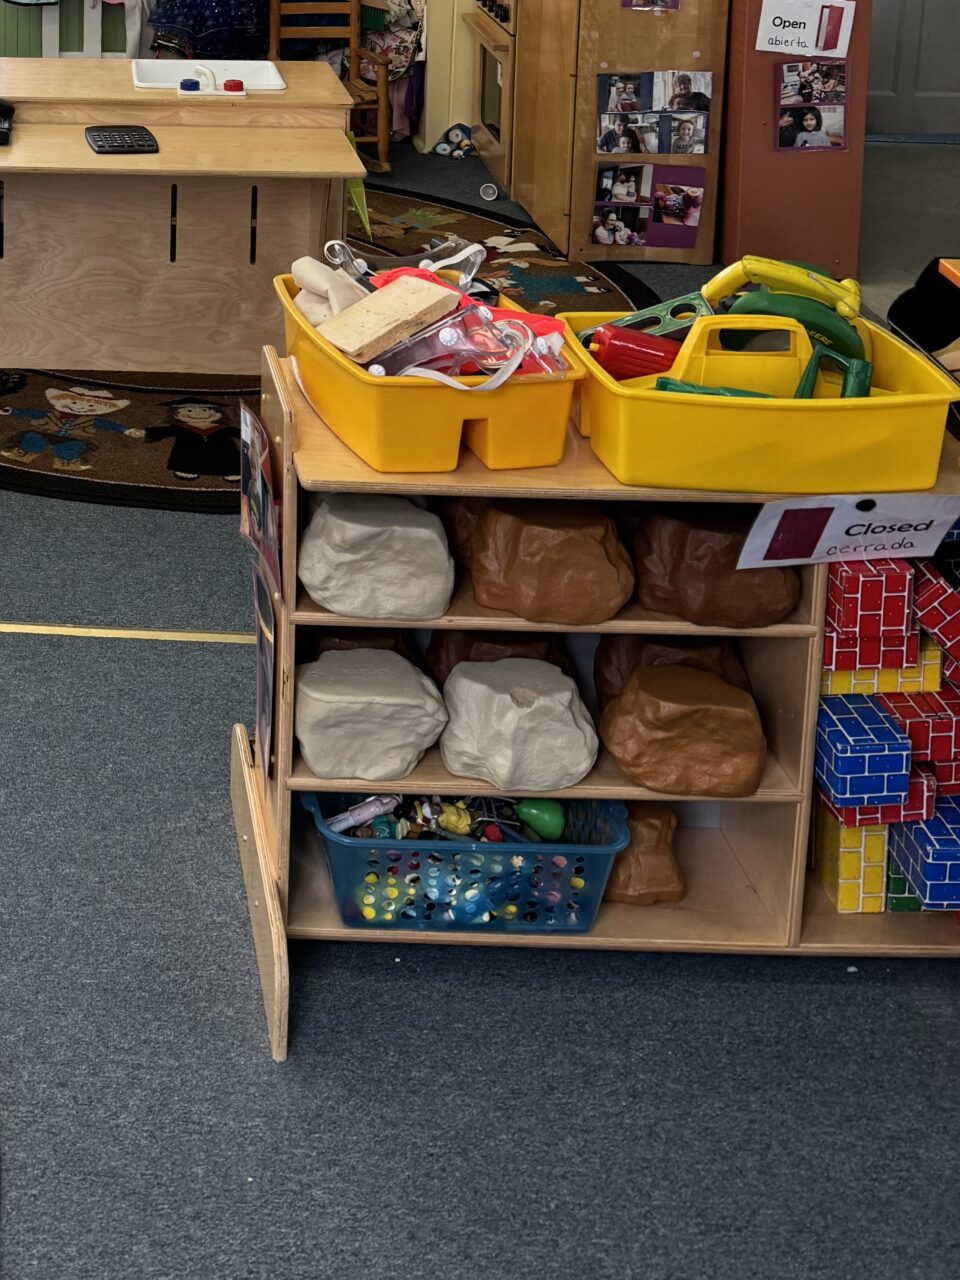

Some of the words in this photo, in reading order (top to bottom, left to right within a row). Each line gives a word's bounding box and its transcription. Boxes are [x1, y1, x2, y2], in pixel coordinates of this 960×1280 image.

[772, 16, 807, 30] Open
[767, 35, 809, 48] abierta
[844, 519, 935, 537] Closed
[825, 537, 916, 556] cerrada
